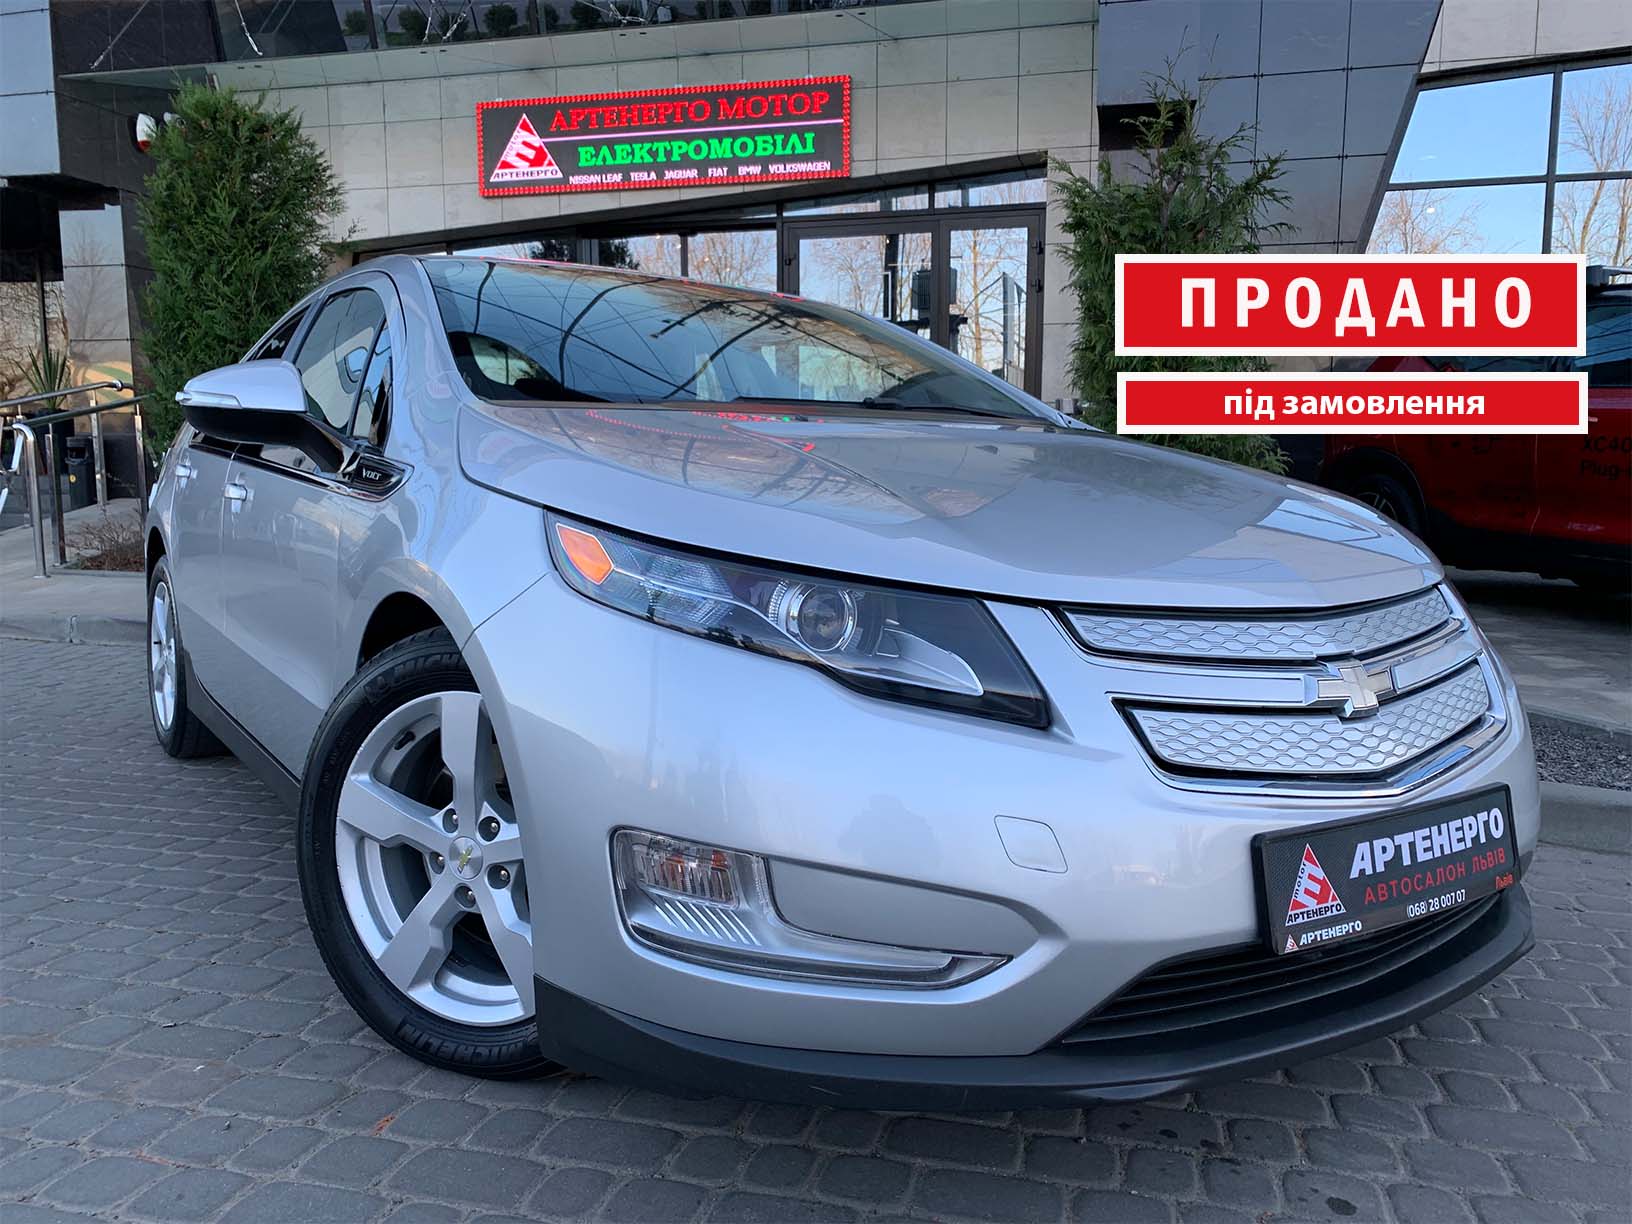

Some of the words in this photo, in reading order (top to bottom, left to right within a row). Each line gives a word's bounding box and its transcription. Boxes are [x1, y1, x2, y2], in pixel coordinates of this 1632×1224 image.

[549, 99, 712, 132] АРТЕНЕРГО
[717, 92, 830, 120] МОТОР
[577, 132, 816, 168] ЕЛЕКТРОМОБІЛІ
[493, 168, 559, 180] АРТЕНЕРГО
[569, 174, 601, 185] NISSAN
[601, 173, 623, 183] LEAF
[630, 170, 657, 180] TESLA
[664, 168, 699, 180] JAGUAR
[708, 166, 729, 177] FIAT
[738, 165, 762, 176] BMW
[769, 161, 831, 174] VOLKSWAGEN
[362, 467, 382, 481] VOLT
[1349, 807, 1505, 880] АРТЕНЕРГО
[1294, 862, 1306, 899] motor
[1364, 861, 1466, 905] АВТОСАЛОН
[1471, 847, 1506, 873] ЛЬВІВ
[1407, 902, 1429, 919] (068)
[1429, 897, 1440, 911] 28
[1441, 892, 1456, 909] 007
[1456, 889, 1467, 904] 07
[1299, 919, 1363, 946] АРТЕНЕРГО
